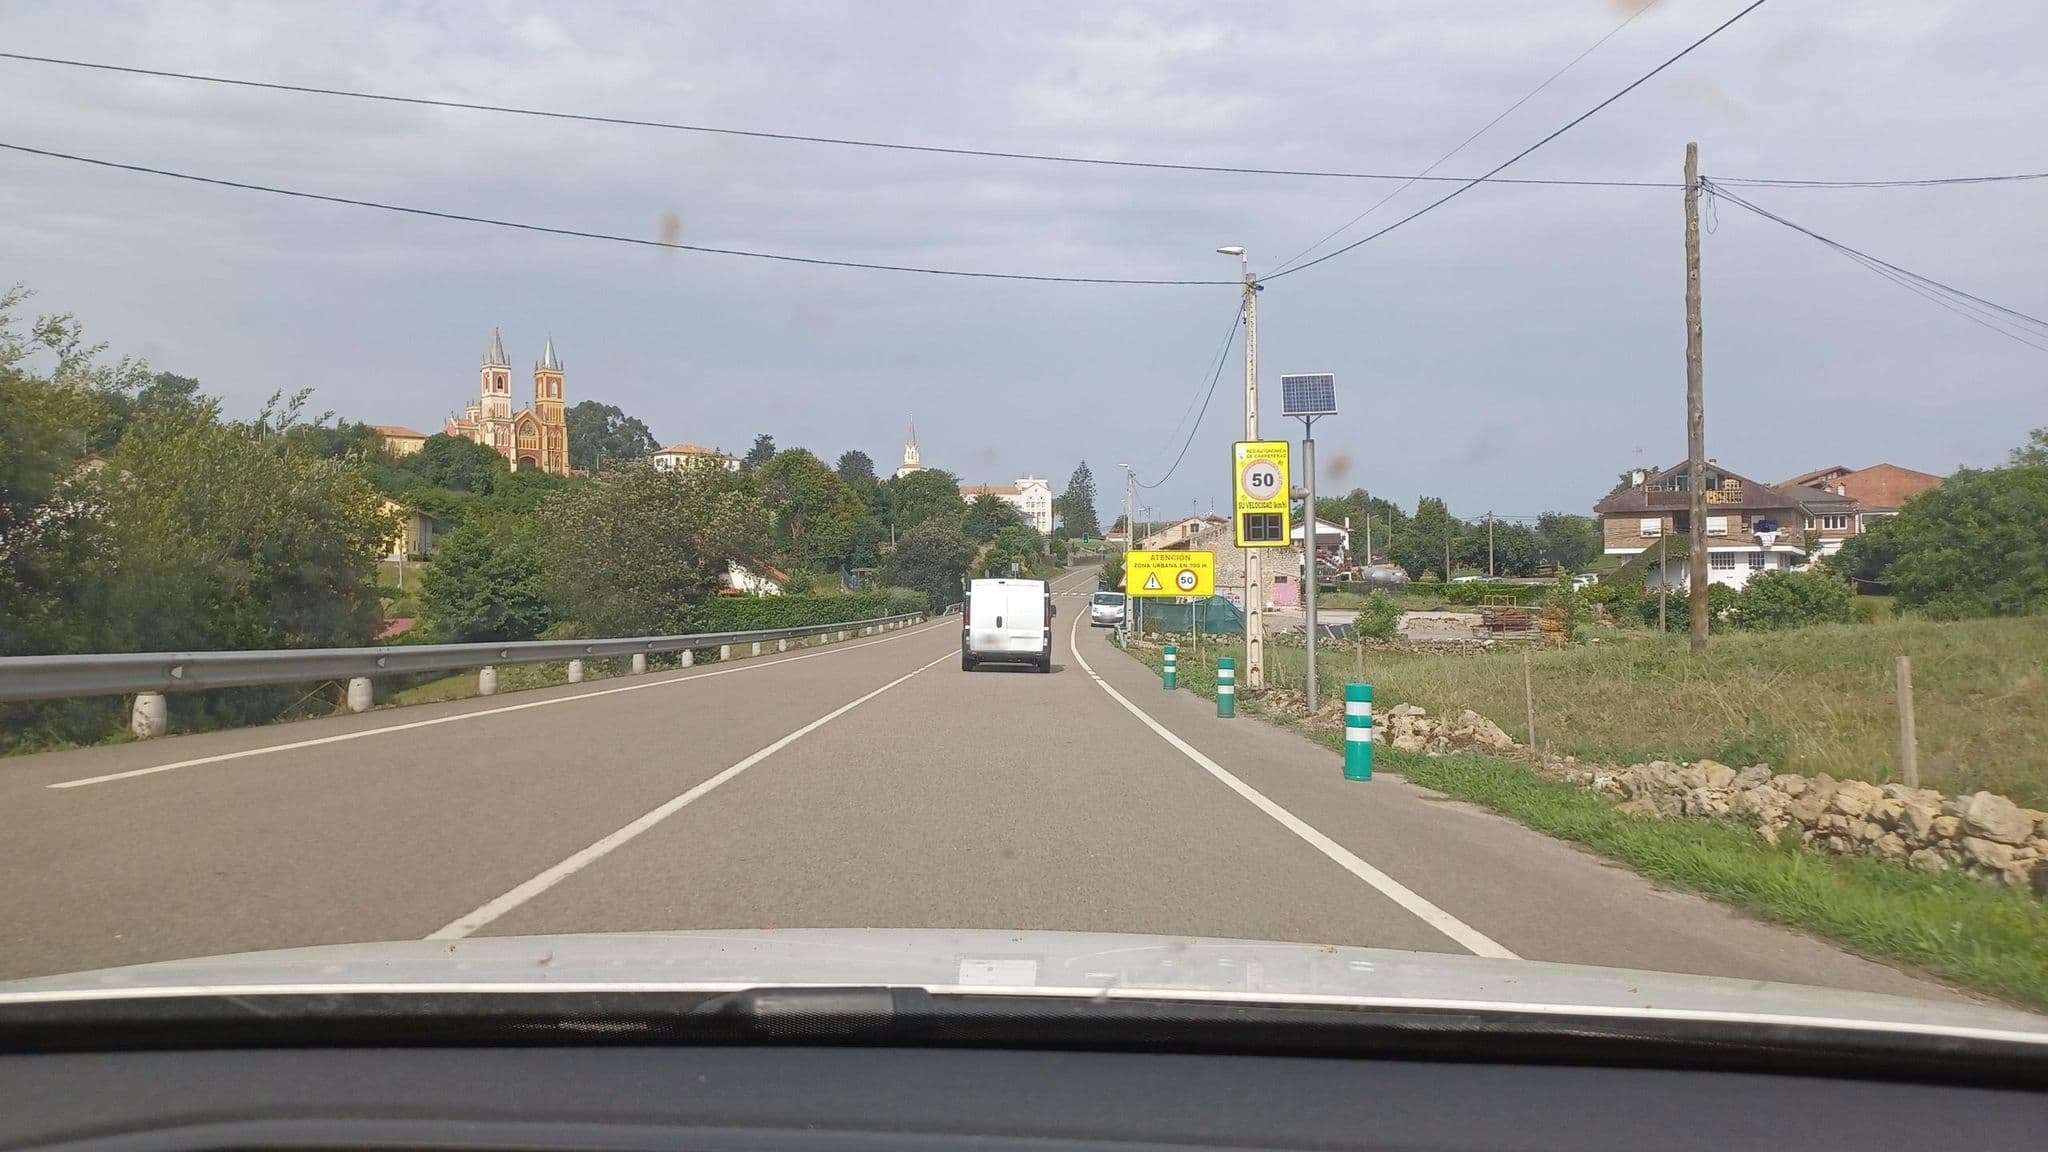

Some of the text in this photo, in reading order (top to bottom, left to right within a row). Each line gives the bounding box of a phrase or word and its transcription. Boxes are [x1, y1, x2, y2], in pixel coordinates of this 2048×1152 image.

[1252, 473, 1274, 487] 50
[1150, 553, 1191, 561] ATENCIÓN
[1180, 576, 1194, 585] 50
